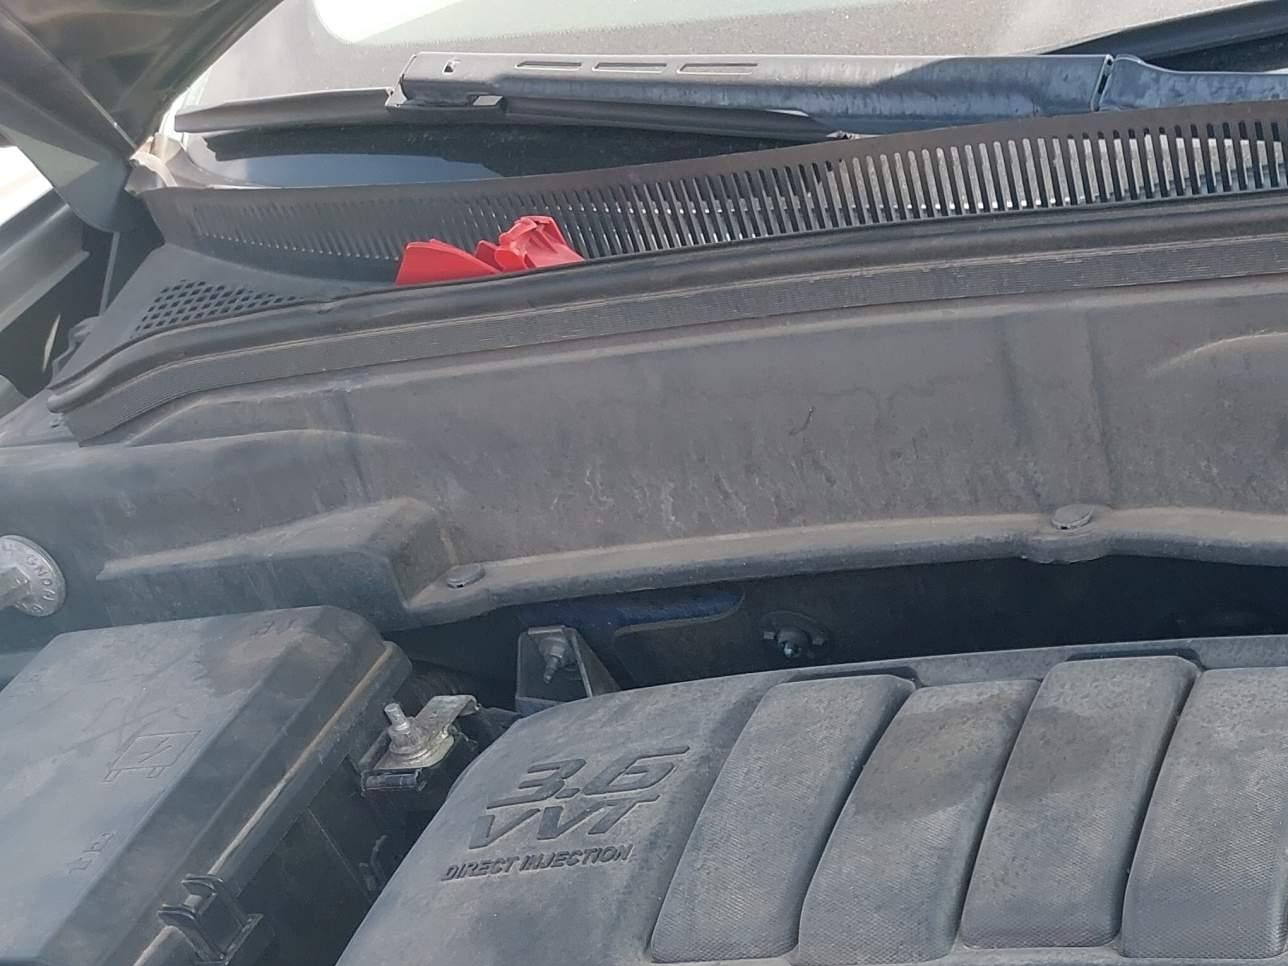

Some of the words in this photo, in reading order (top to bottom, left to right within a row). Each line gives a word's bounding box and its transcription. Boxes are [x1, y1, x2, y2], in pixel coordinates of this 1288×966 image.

[468, 795, 661, 850] VVT
[440, 855, 521, 881] DIRECT
[519, 844, 634, 873] INJECTION
